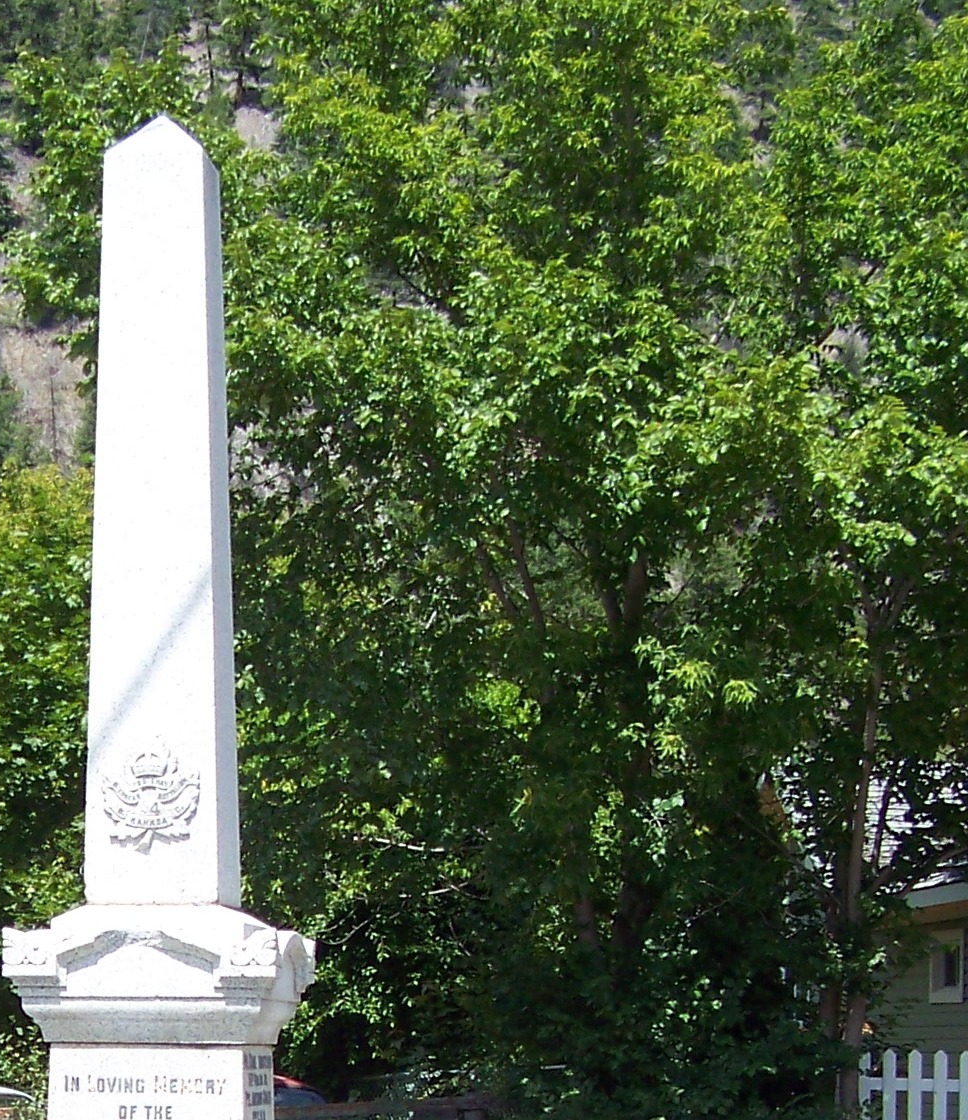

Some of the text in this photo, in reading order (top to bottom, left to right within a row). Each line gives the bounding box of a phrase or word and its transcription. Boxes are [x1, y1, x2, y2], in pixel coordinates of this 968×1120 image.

[64, 1075, 80, 1093] IN
[87, 1075, 145, 1094] LOVING
[118, 1105, 173, 1120] OF THE
